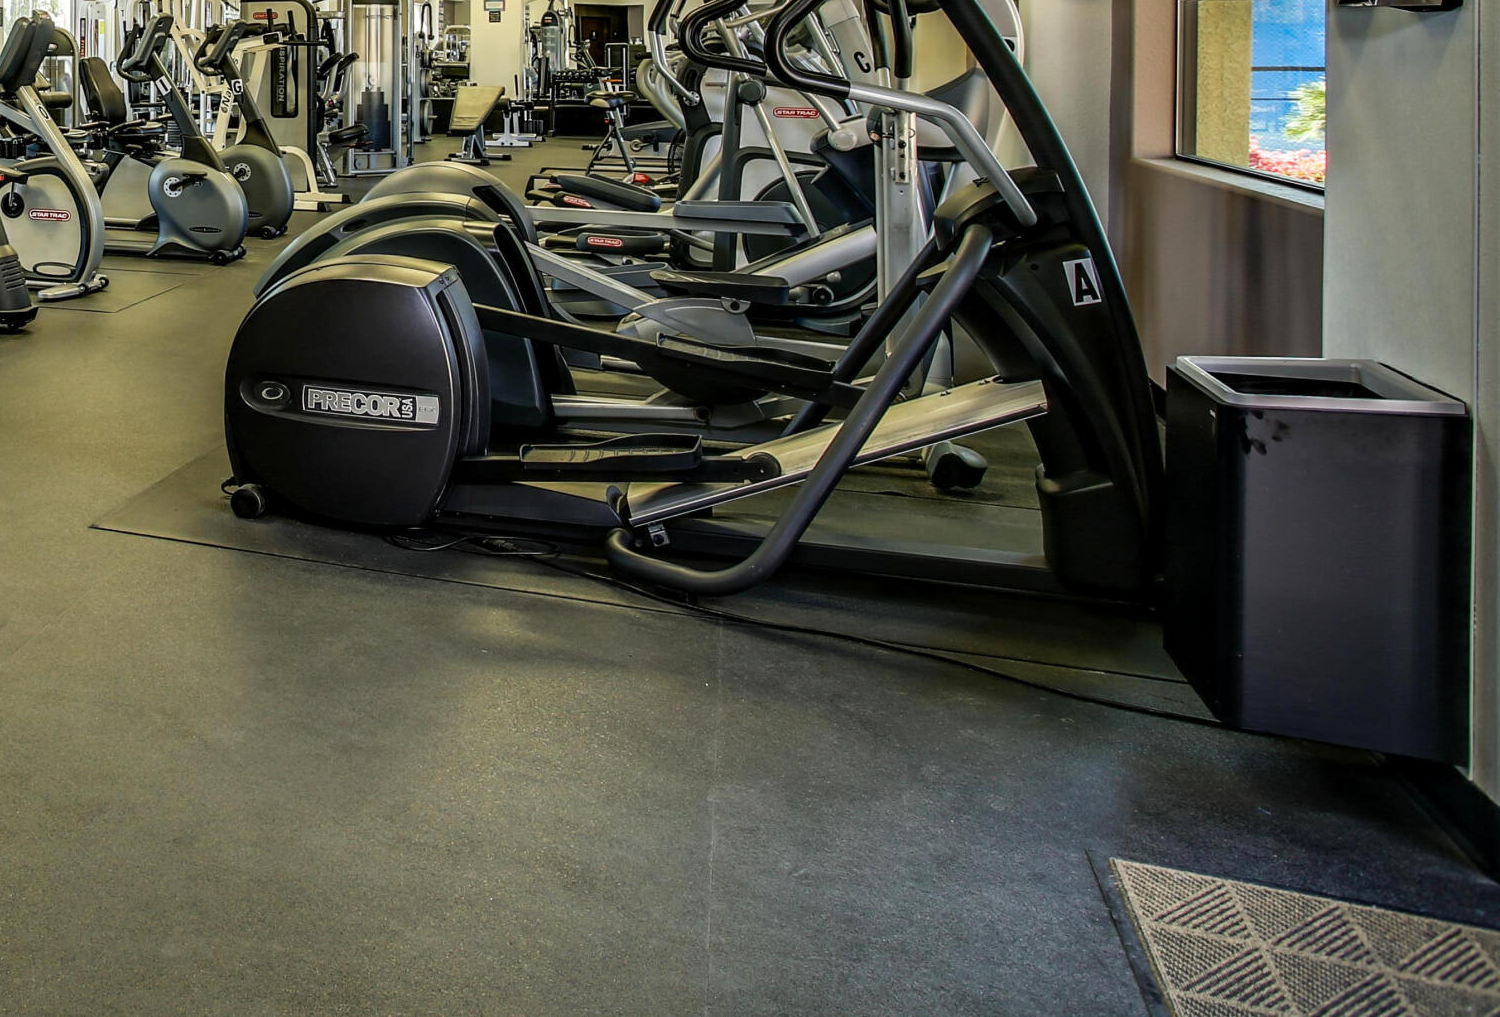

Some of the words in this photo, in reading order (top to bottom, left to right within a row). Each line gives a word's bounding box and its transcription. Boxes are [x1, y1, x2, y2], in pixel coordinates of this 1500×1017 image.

[278, 47, 286, 102] SPIRATION
[853, 51, 871, 74] C
[233, 80, 242, 93] G
[1074, 262, 1100, 303] A
[307, 388, 401, 418] PRECOR
[401, 398, 413, 418] USA
